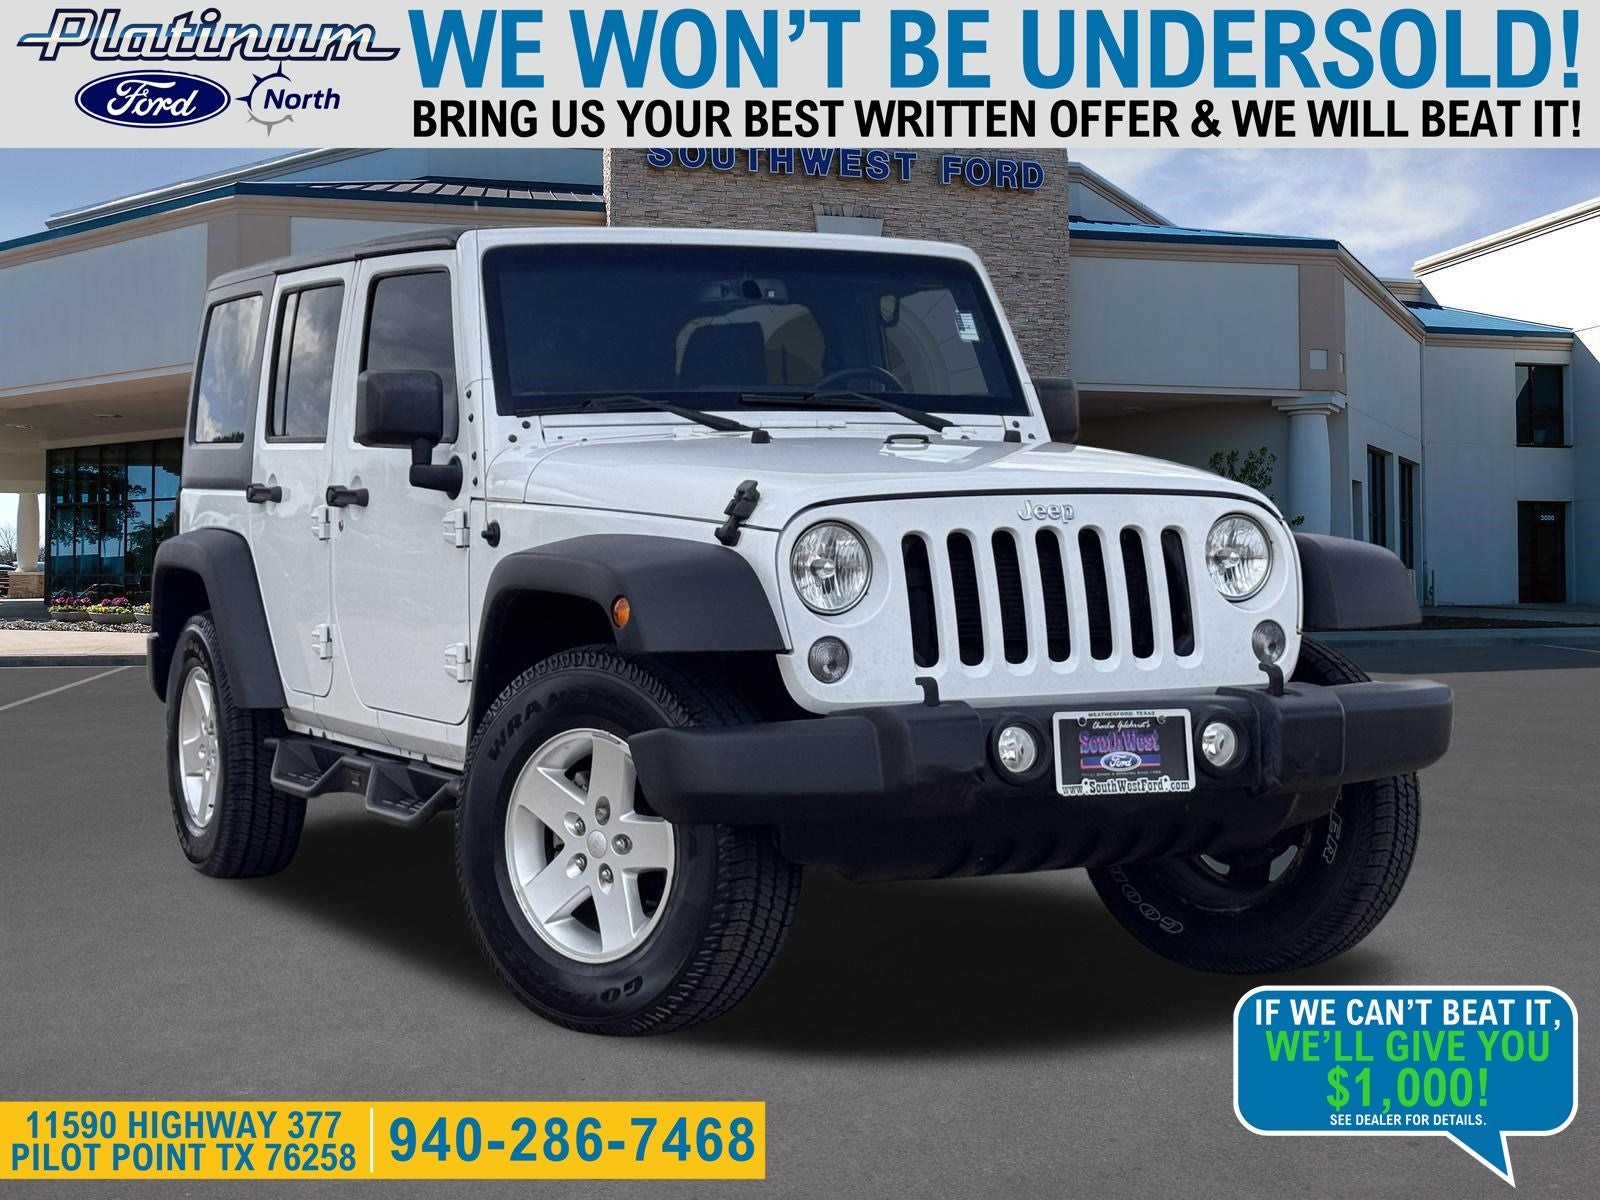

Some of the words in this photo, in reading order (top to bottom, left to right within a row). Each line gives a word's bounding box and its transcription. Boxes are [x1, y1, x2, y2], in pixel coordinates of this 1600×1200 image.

[647, 148, 917, 181] SOUTHWEST
[941, 155, 1045, 190] FORD
[1017, 499, 1074, 524] Jeep
[1109, 755, 1132, 768] Ford
